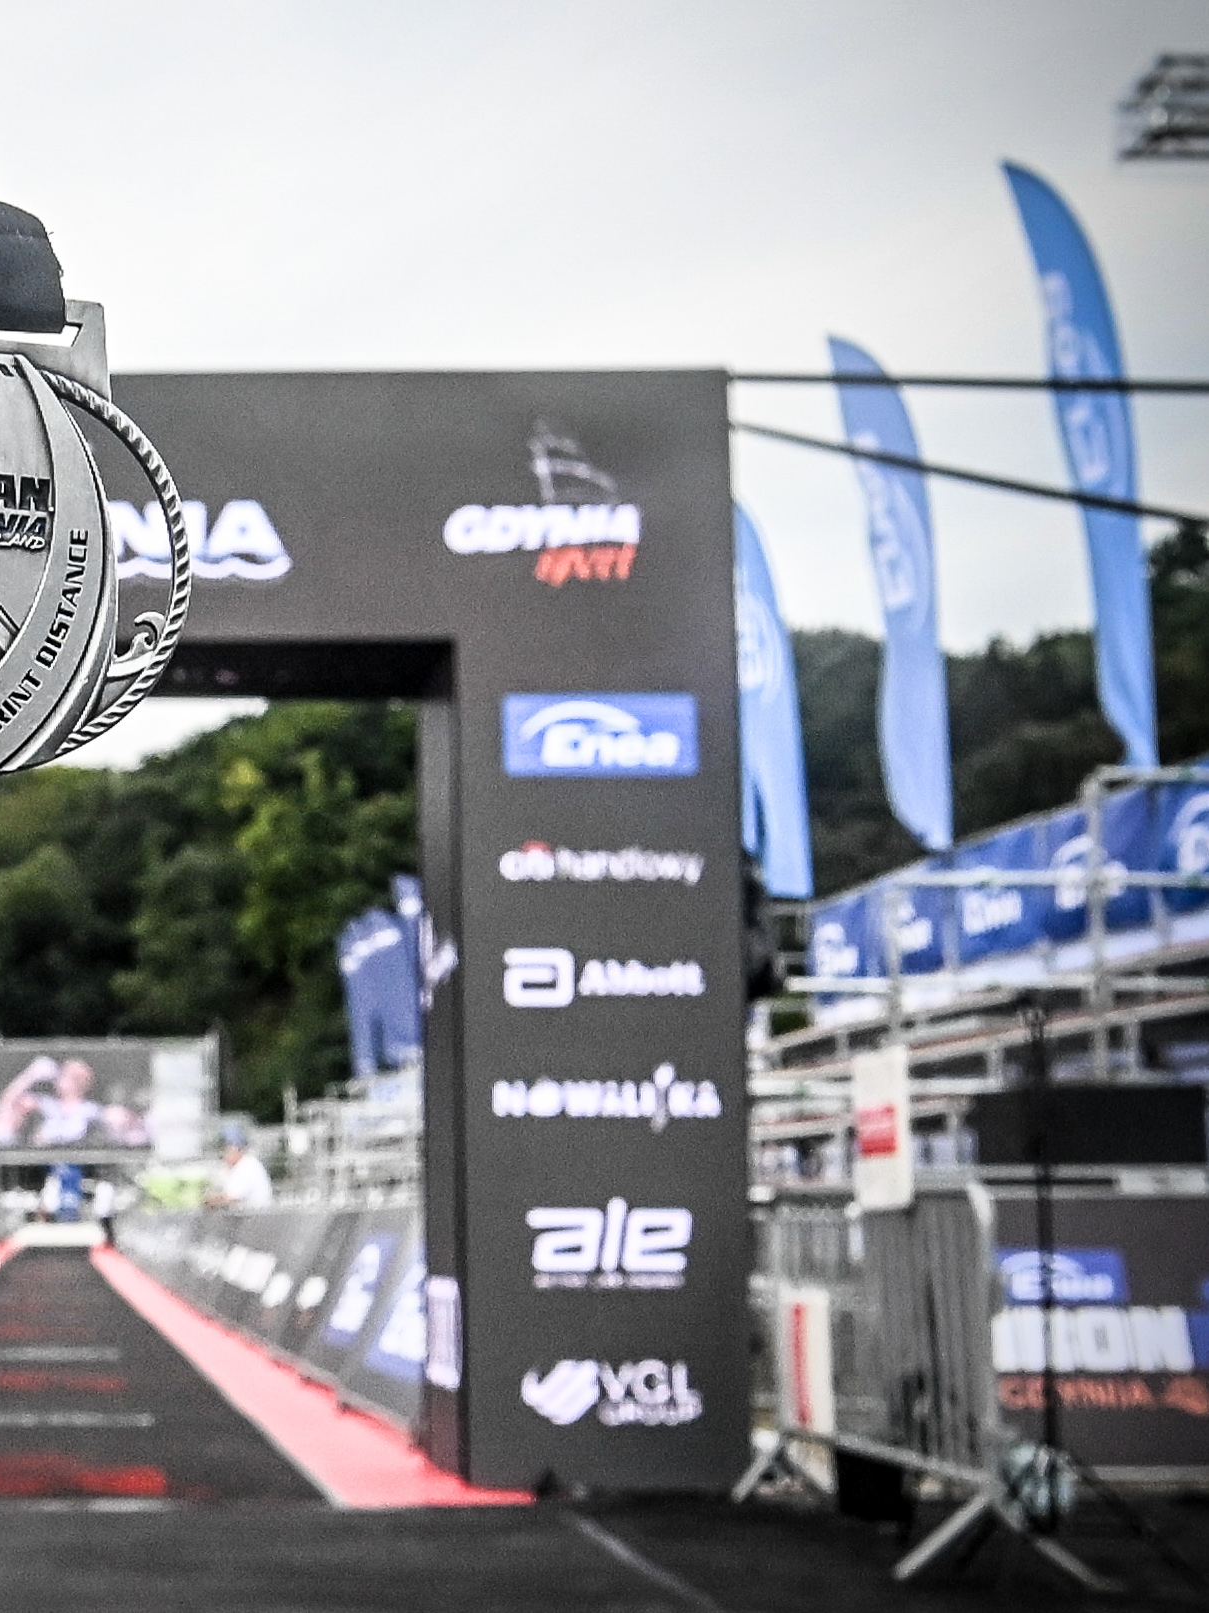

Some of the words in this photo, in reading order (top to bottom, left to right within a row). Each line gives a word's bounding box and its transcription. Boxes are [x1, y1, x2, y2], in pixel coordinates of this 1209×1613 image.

[36, 529, 88, 667] DISTANCE
[526, 1197, 693, 1272] ale
[600, 1359, 695, 1402] VGL
